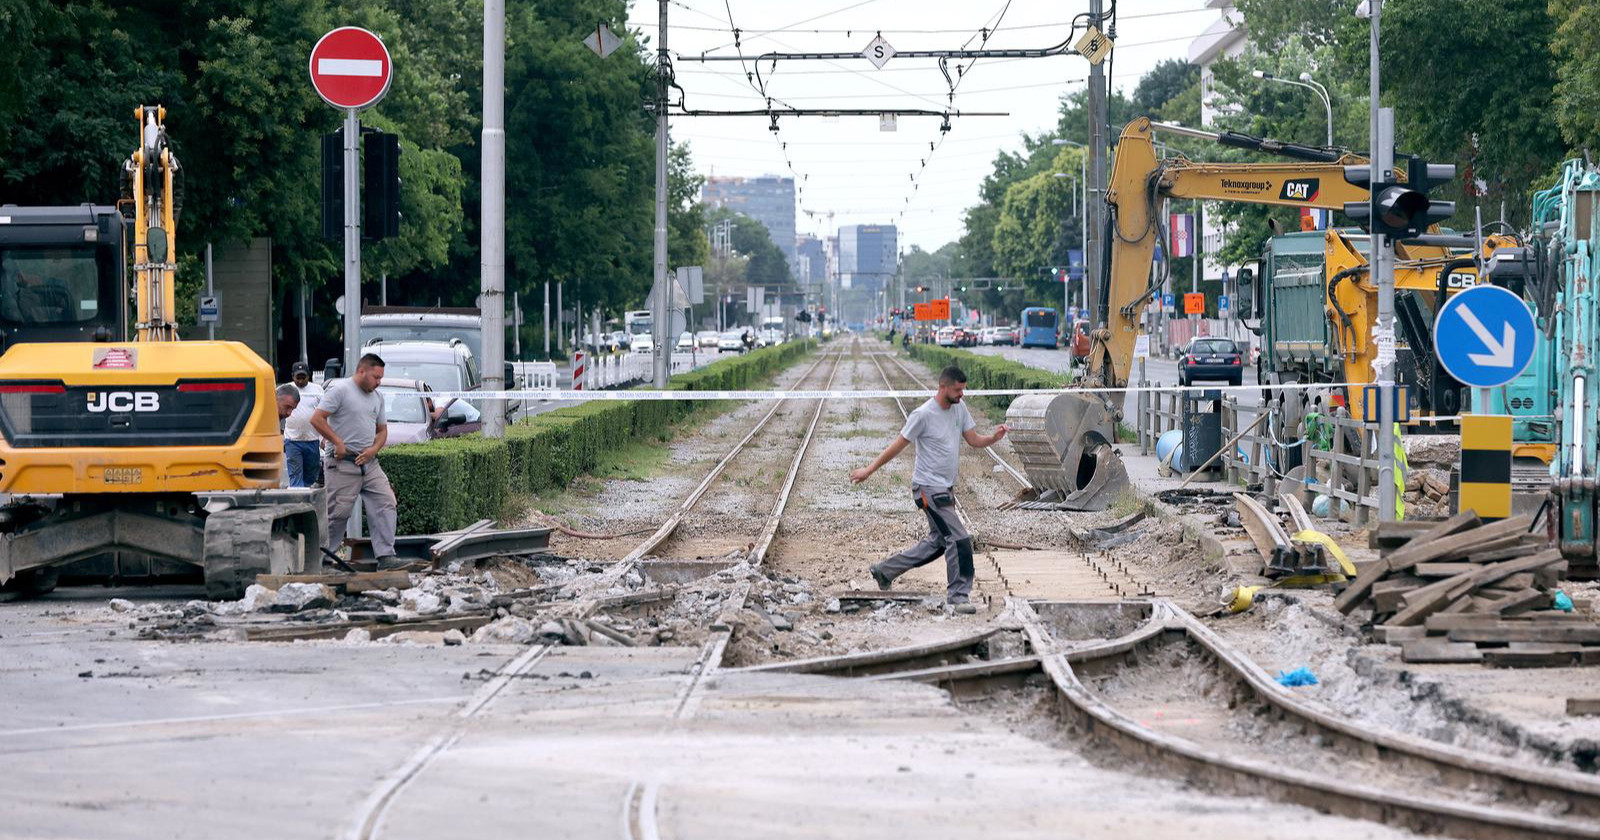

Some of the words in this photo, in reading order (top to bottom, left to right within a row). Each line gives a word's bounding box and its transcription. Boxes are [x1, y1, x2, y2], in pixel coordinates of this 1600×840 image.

[874, 45, 884, 59] S
[1220, 179, 1265, 191] Teknoxgroup
[1286, 182, 1310, 199] CAT
[86, 391, 160, 413] JCB
